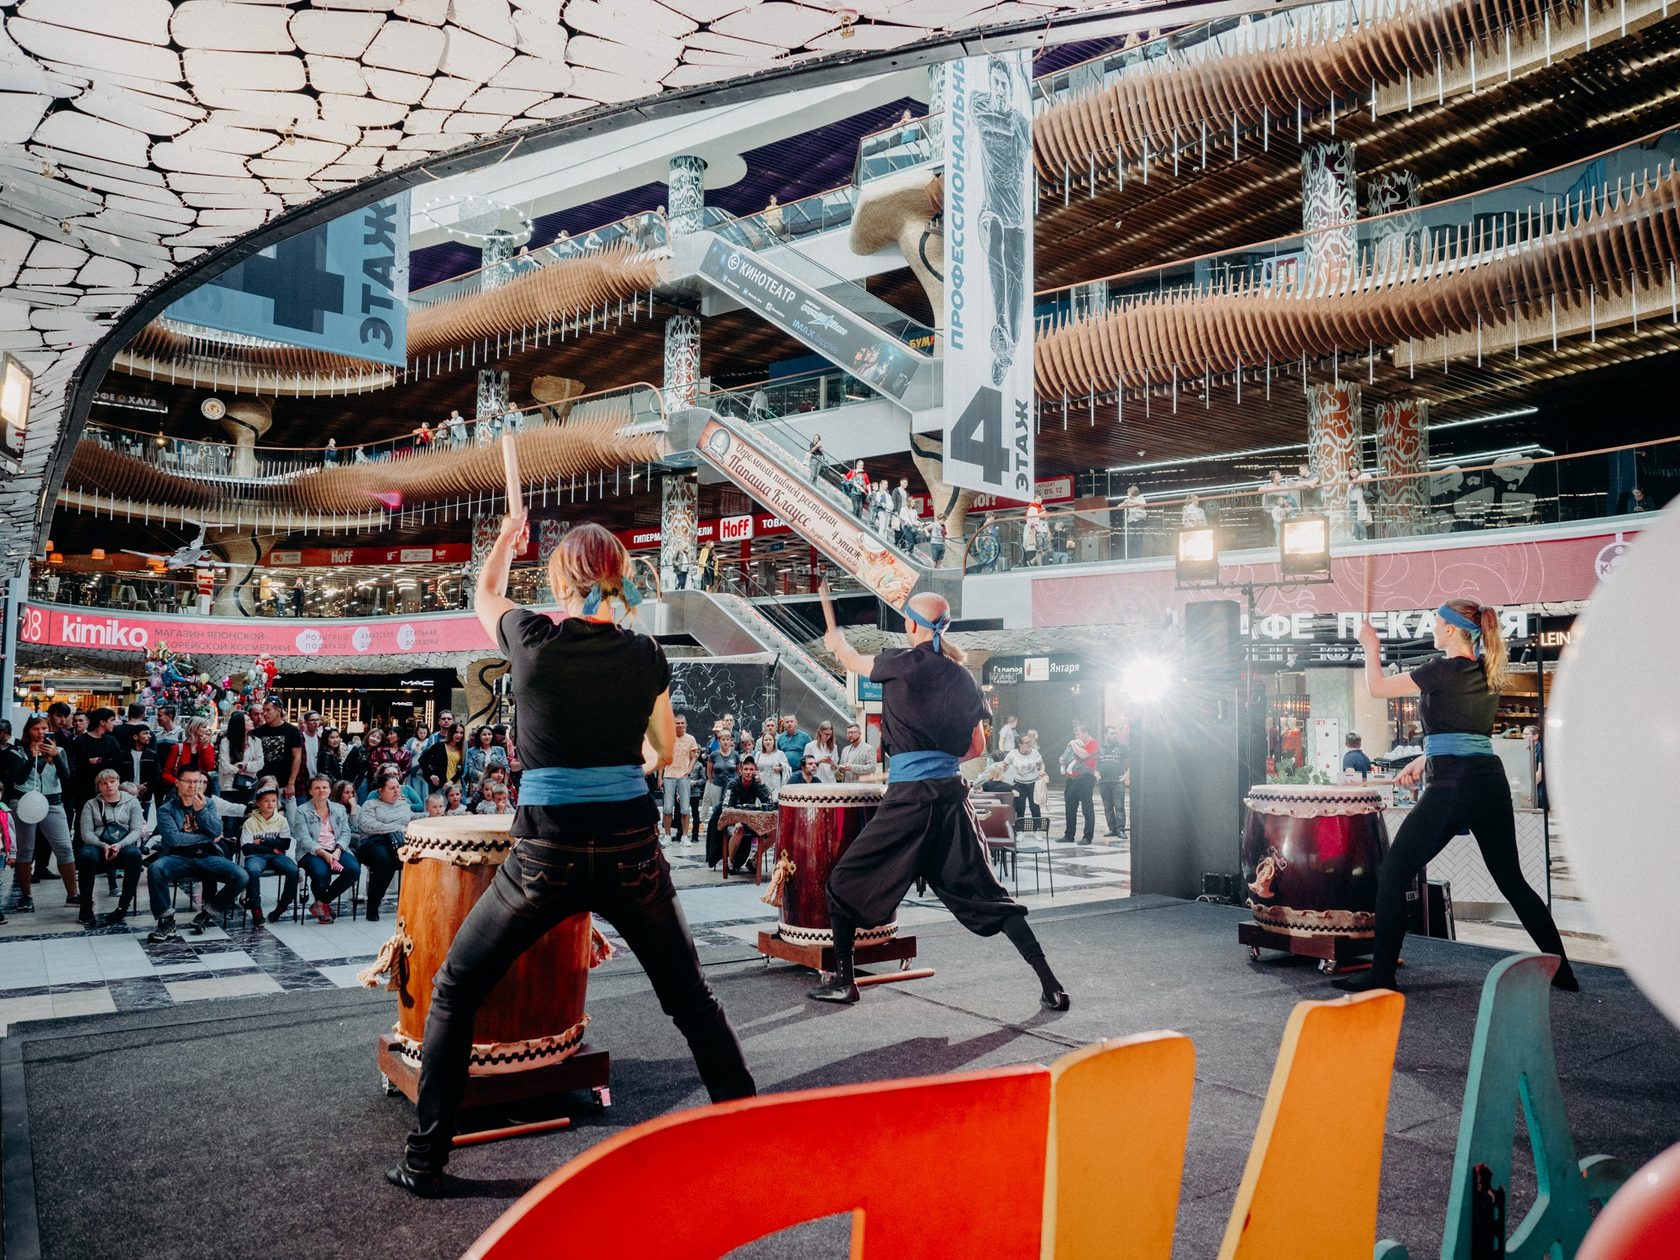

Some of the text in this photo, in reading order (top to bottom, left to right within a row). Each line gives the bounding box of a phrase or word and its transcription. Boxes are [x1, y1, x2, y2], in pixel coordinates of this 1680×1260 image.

[360, 199, 397, 351] ЭТАЖ
[739, 261, 796, 304] КИНОТЕАТР
[792, 318, 816, 339] IMAX
[94, 390, 157, 407] ОФЕ ХАУЗ
[951, 385, 1011, 487] 4
[1015, 398, 1030, 493] ЭТАЖ
[728, 453, 812, 528] Папаша Клаусс
[735, 442, 839, 528] Огромный пивной ресторан
[836, 538, 863, 561] этаж
[62, 615, 149, 648] kimiko
[154, 629, 265, 640] МАГАЗИН ЯПОНСКОЙ
[1540, 631, 1571, 646] LEIN
[231, 643, 291, 652] КОСМЕТИКИ
[1050, 662, 1080, 675] Янтаря
